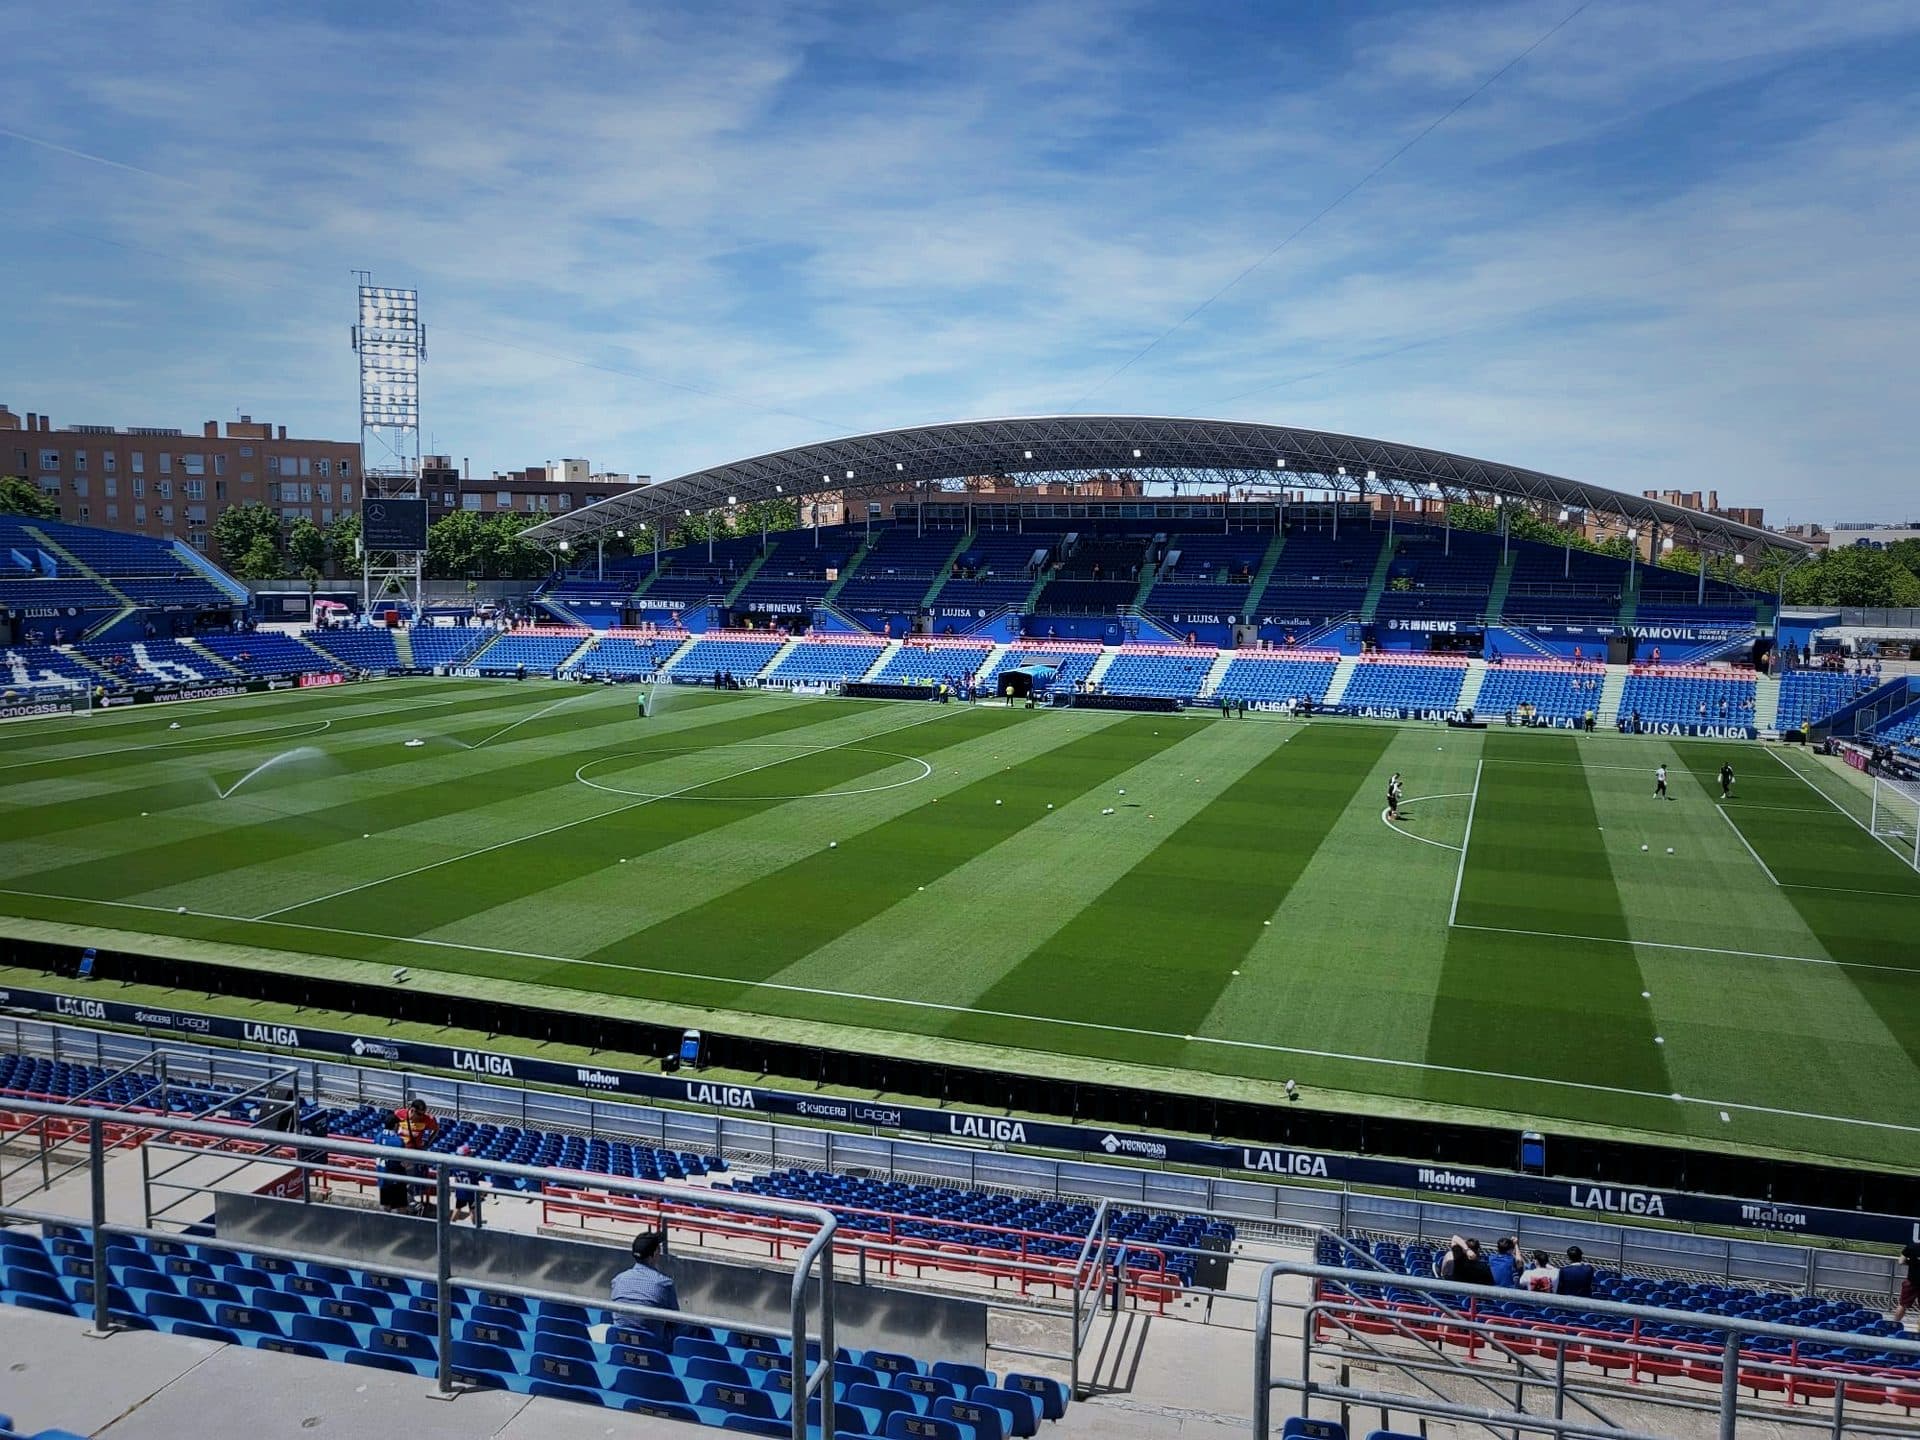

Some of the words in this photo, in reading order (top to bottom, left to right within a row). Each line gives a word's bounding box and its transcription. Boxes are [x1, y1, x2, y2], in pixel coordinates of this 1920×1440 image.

[942, 608, 971, 617] LUJISA
[1187, 614, 1220, 624] LUJISA
[1631, 626, 1694, 640] YAMOVIL
[449, 667, 480, 678] LALIGA
[640, 674, 673, 685] LALIGA
[0, 703, 73, 718] cnocasa.es
[1697, 725, 1748, 740] LALIGA
[56, 996, 106, 1019] LALIGA
[244, 1023, 299, 1046] LALIGA
[453, 1051, 514, 1076] LALIGA
[576, 1068, 620, 1086] Mahou
[686, 1082, 755, 1109] LALIGA
[855, 1106, 901, 1122] LAGOM
[950, 1115, 1026, 1143] LALIGA
[1121, 1139, 1167, 1155] TECNOCASA
[1243, 1149, 1328, 1177] LALIGA
[1418, 1168, 1476, 1188] Mahou
[1570, 1185, 1665, 1217] LALIGA
[1741, 1204, 1807, 1226] Mahou
